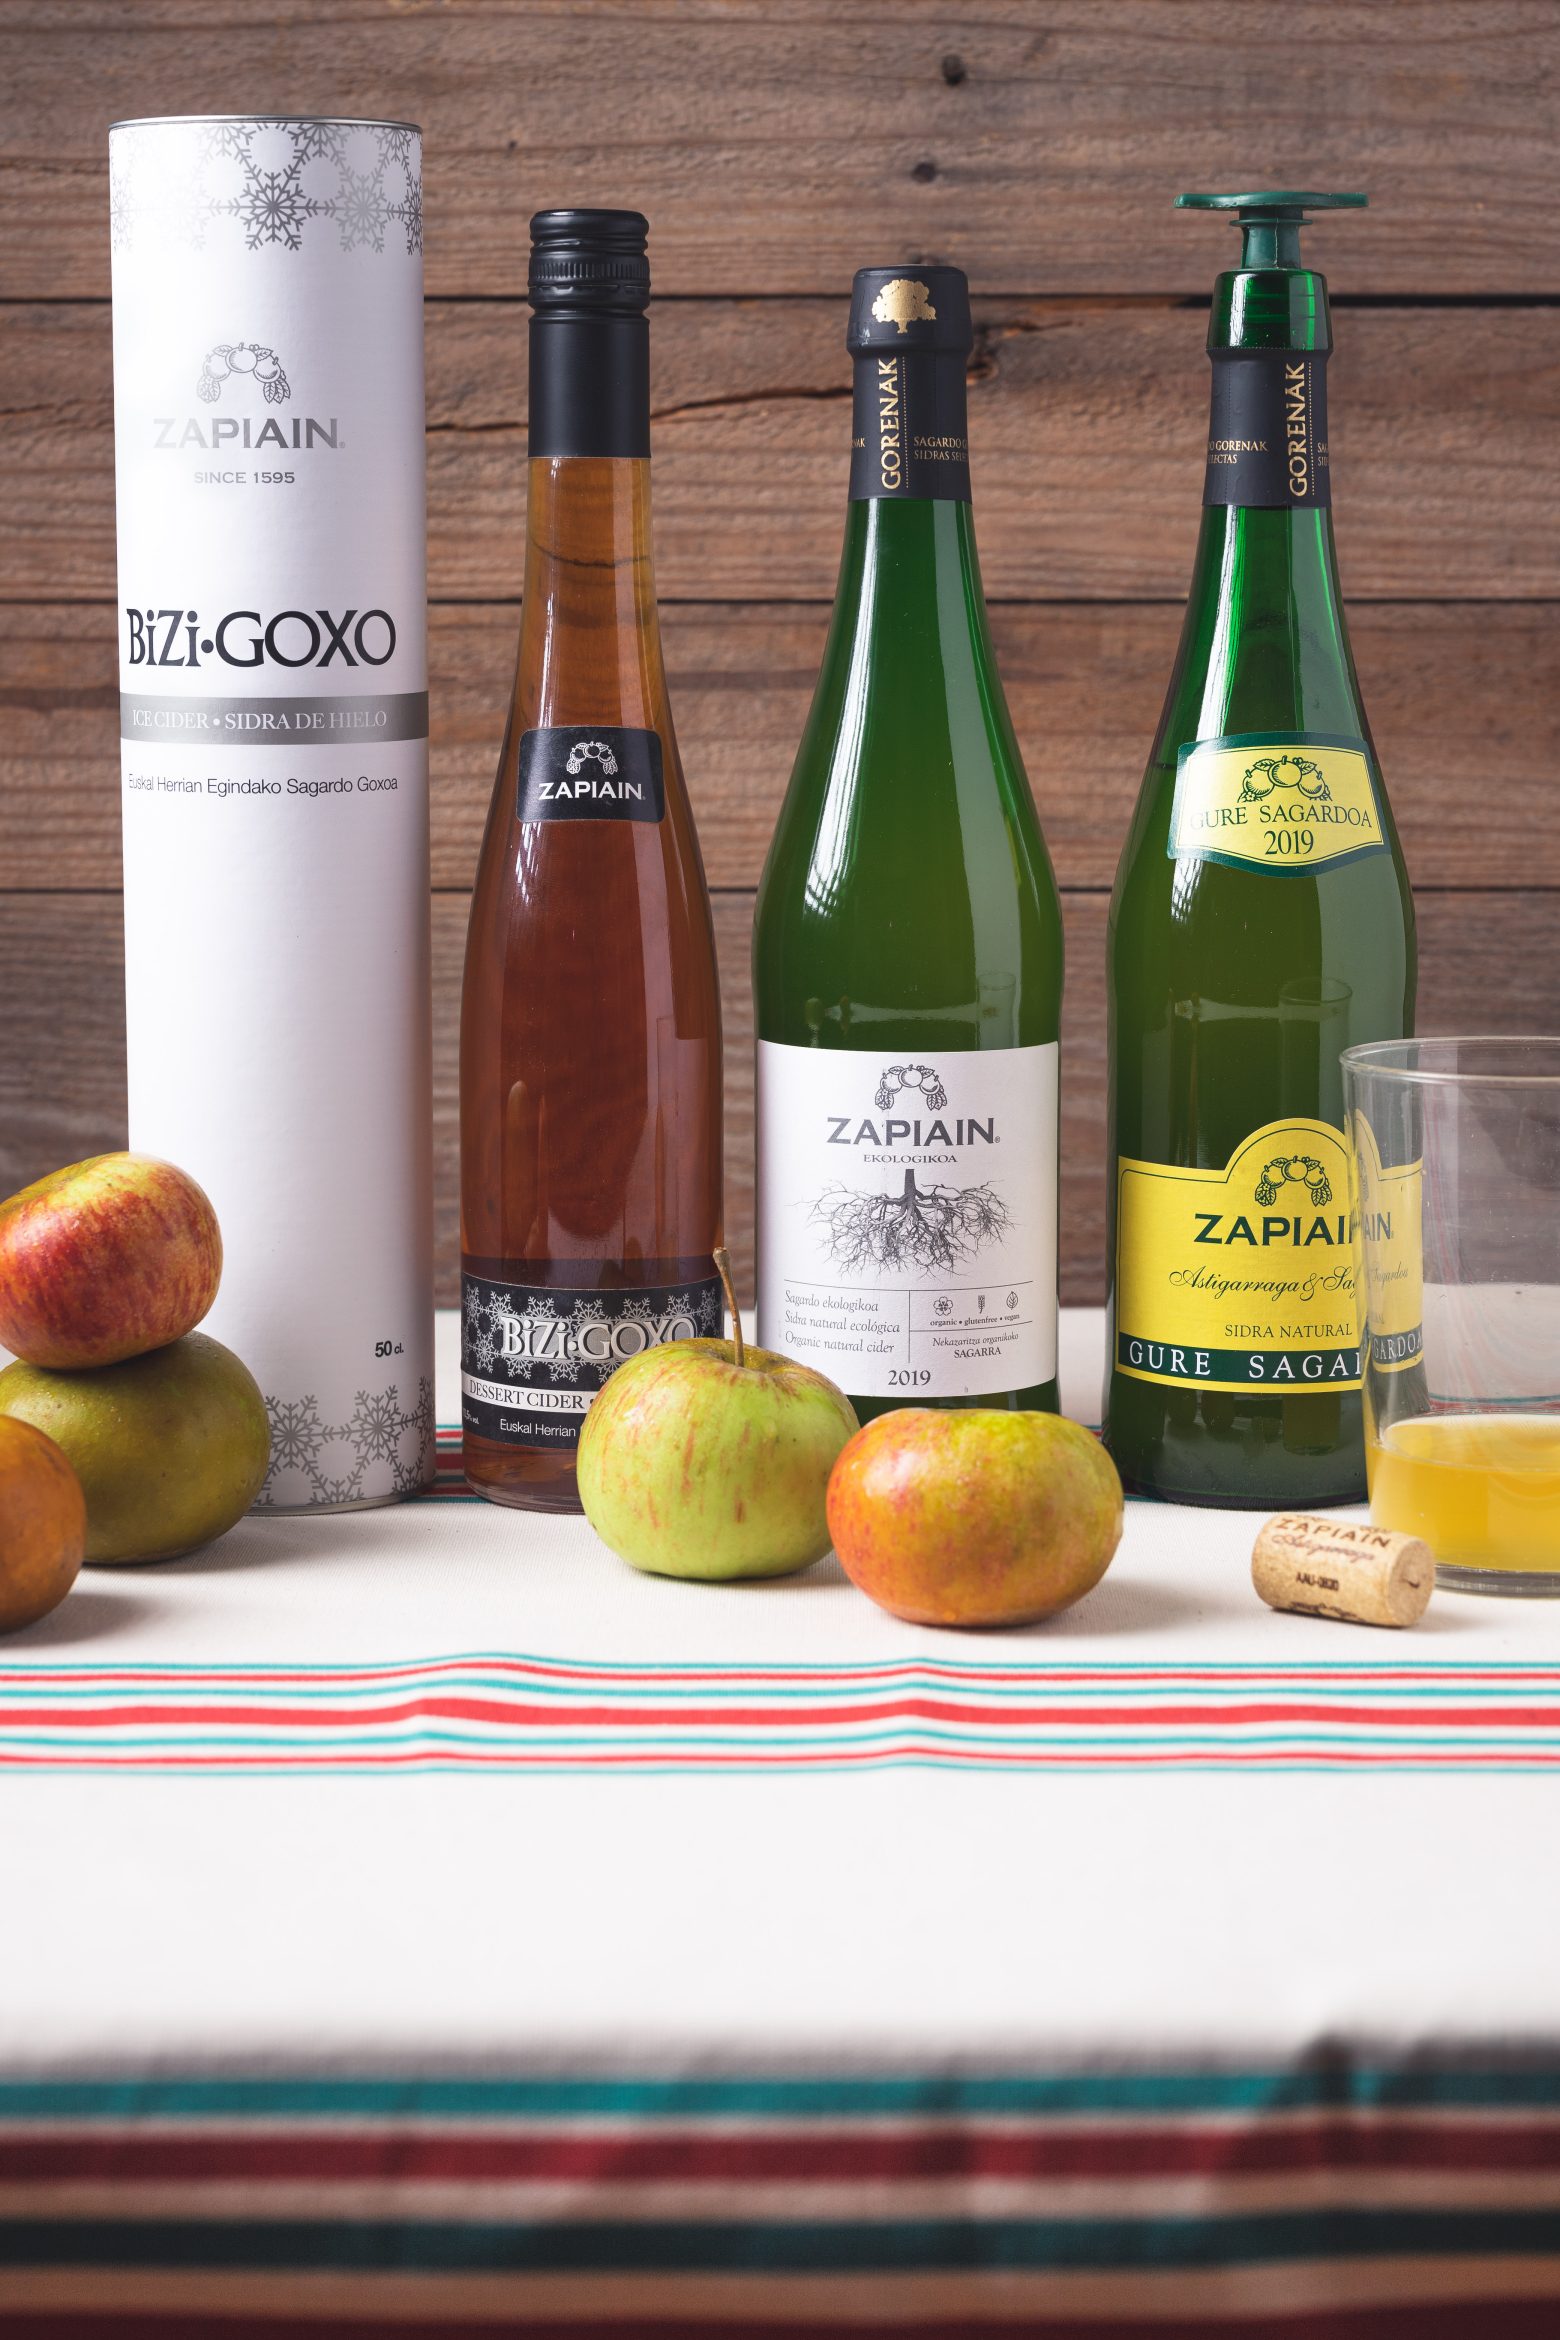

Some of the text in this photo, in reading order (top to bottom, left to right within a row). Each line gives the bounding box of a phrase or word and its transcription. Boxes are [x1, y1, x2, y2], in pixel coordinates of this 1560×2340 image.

[153, 418, 339, 449] ZAPIAIN
[878, 357, 900, 490] GORENAK
[1285, 361, 1308, 497] GORENAK
[914, 436, 961, 448] SAGARDO
[1216, 440, 1269, 451] GORENAK
[194, 472, 295, 484] SINCE 1595
[133, 709, 387, 730] ICE CIDER SIDRA DE HIELO
[129, 773, 398, 797] Euskal Herrian Egindako Sagardo Goxoa
[538, 781, 642, 800] ZAPIAIN
[1190, 804, 1372, 830] GURE SAGARDOA
[1264, 829, 1314, 855] 2019
[826, 1117, 996, 1147] ZAPIAIN
[863, 1154, 958, 1164] EKOLOGIKOA
[1194, 1213, 1353, 1246] ZAPIAI
[1169, 1265, 1300, 1301] Astigarraga
[785, 1290, 879, 1313] Sagardo ekologikoa
[785, 1309, 900, 1335] Sidra natural ecológica
[930, 1319, 957, 1327] organic
[964, 1316, 998, 1326] glutenfree
[1224, 1323, 1353, 1338] SIDRA NATURAL
[375, 1341, 392, 1357] 50
[785, 1331, 894, 1353] Organic natural cider
[954, 1346, 1001, 1358] SAGARRA
[1129, 1341, 1211, 1376] GURE
[888, 1370, 931, 1386] 2019
[470, 1380, 585, 1409] DESSERT CIDER
[500, 1419, 576, 1437] Euskal Herrian
